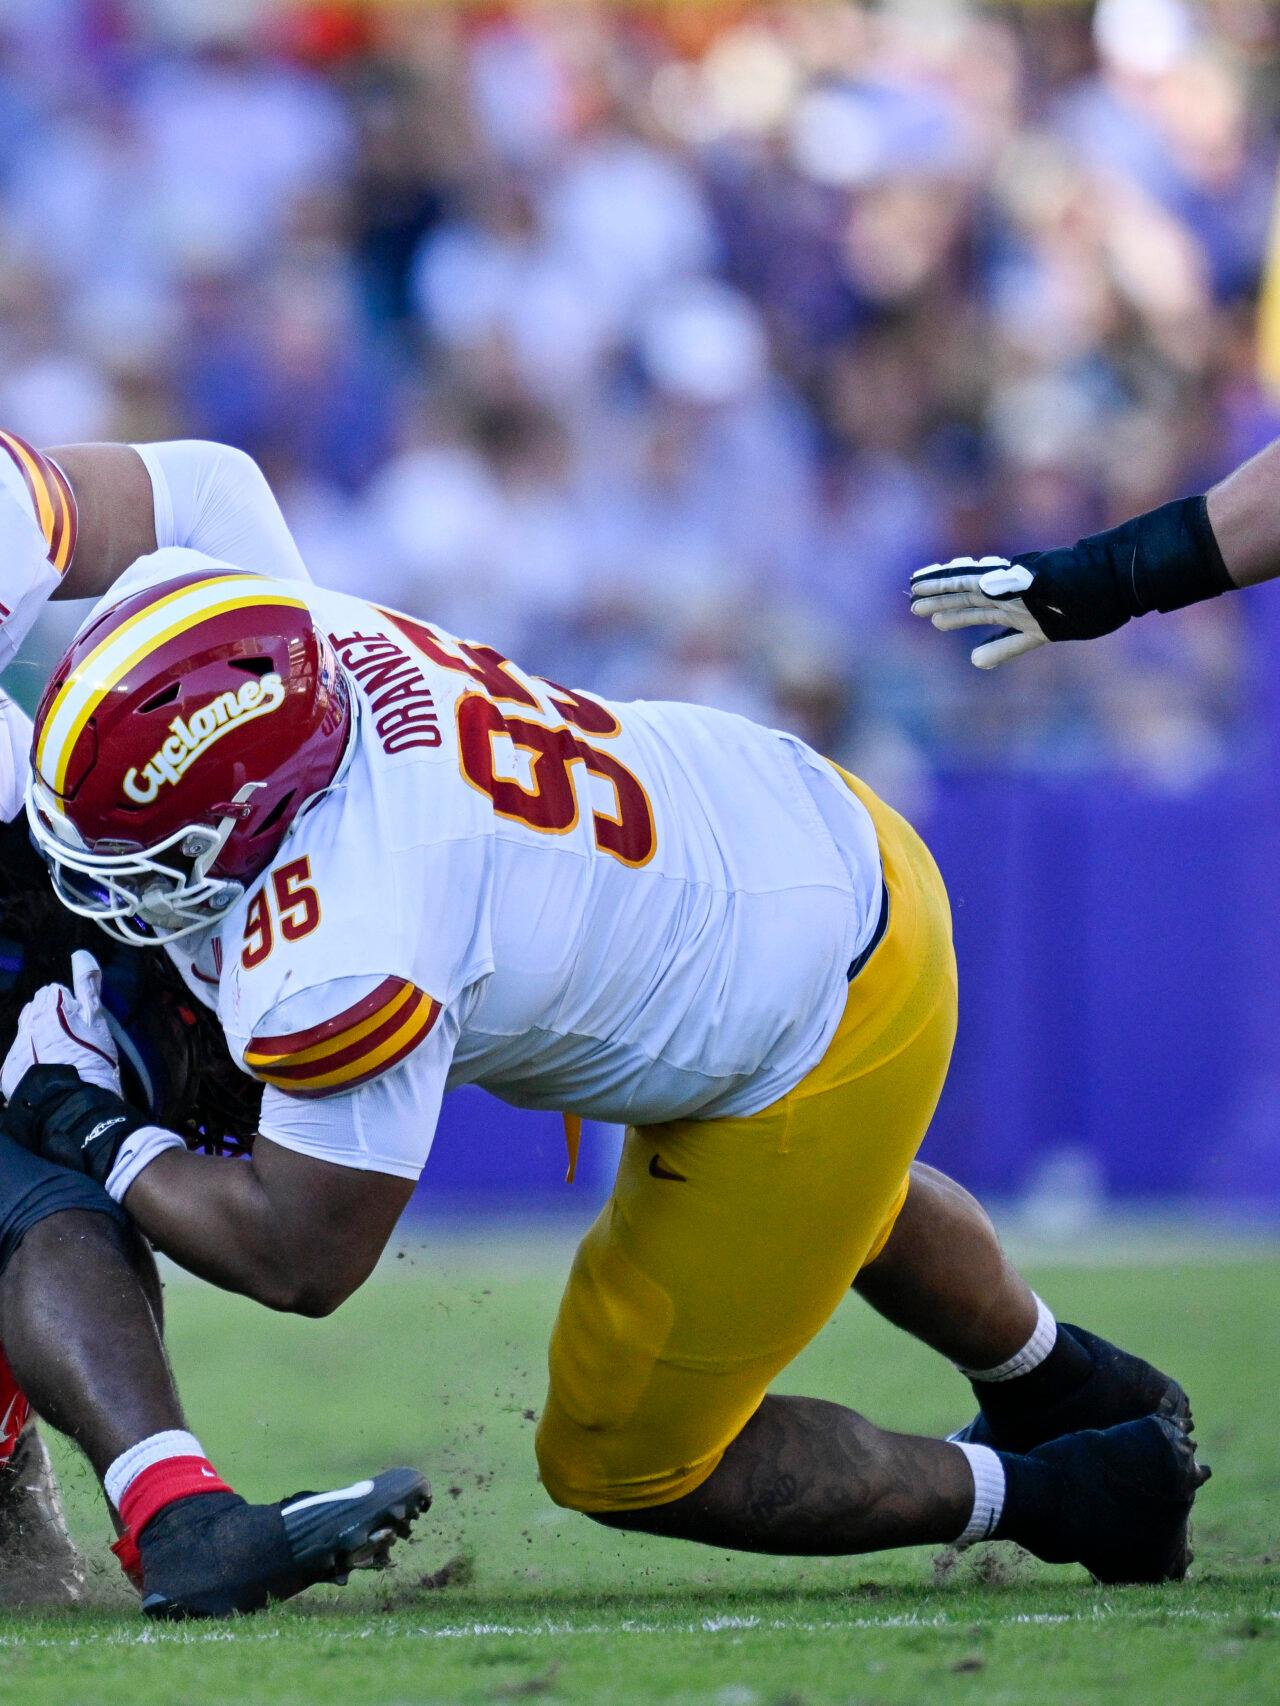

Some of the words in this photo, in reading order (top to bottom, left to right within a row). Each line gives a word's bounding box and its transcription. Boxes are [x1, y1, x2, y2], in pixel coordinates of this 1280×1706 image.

[122, 673, 286, 804] Cyclones
[327, 631, 442, 755] ORANGE
[368, 602, 658, 869] 95
[241, 853, 321, 971] 95
